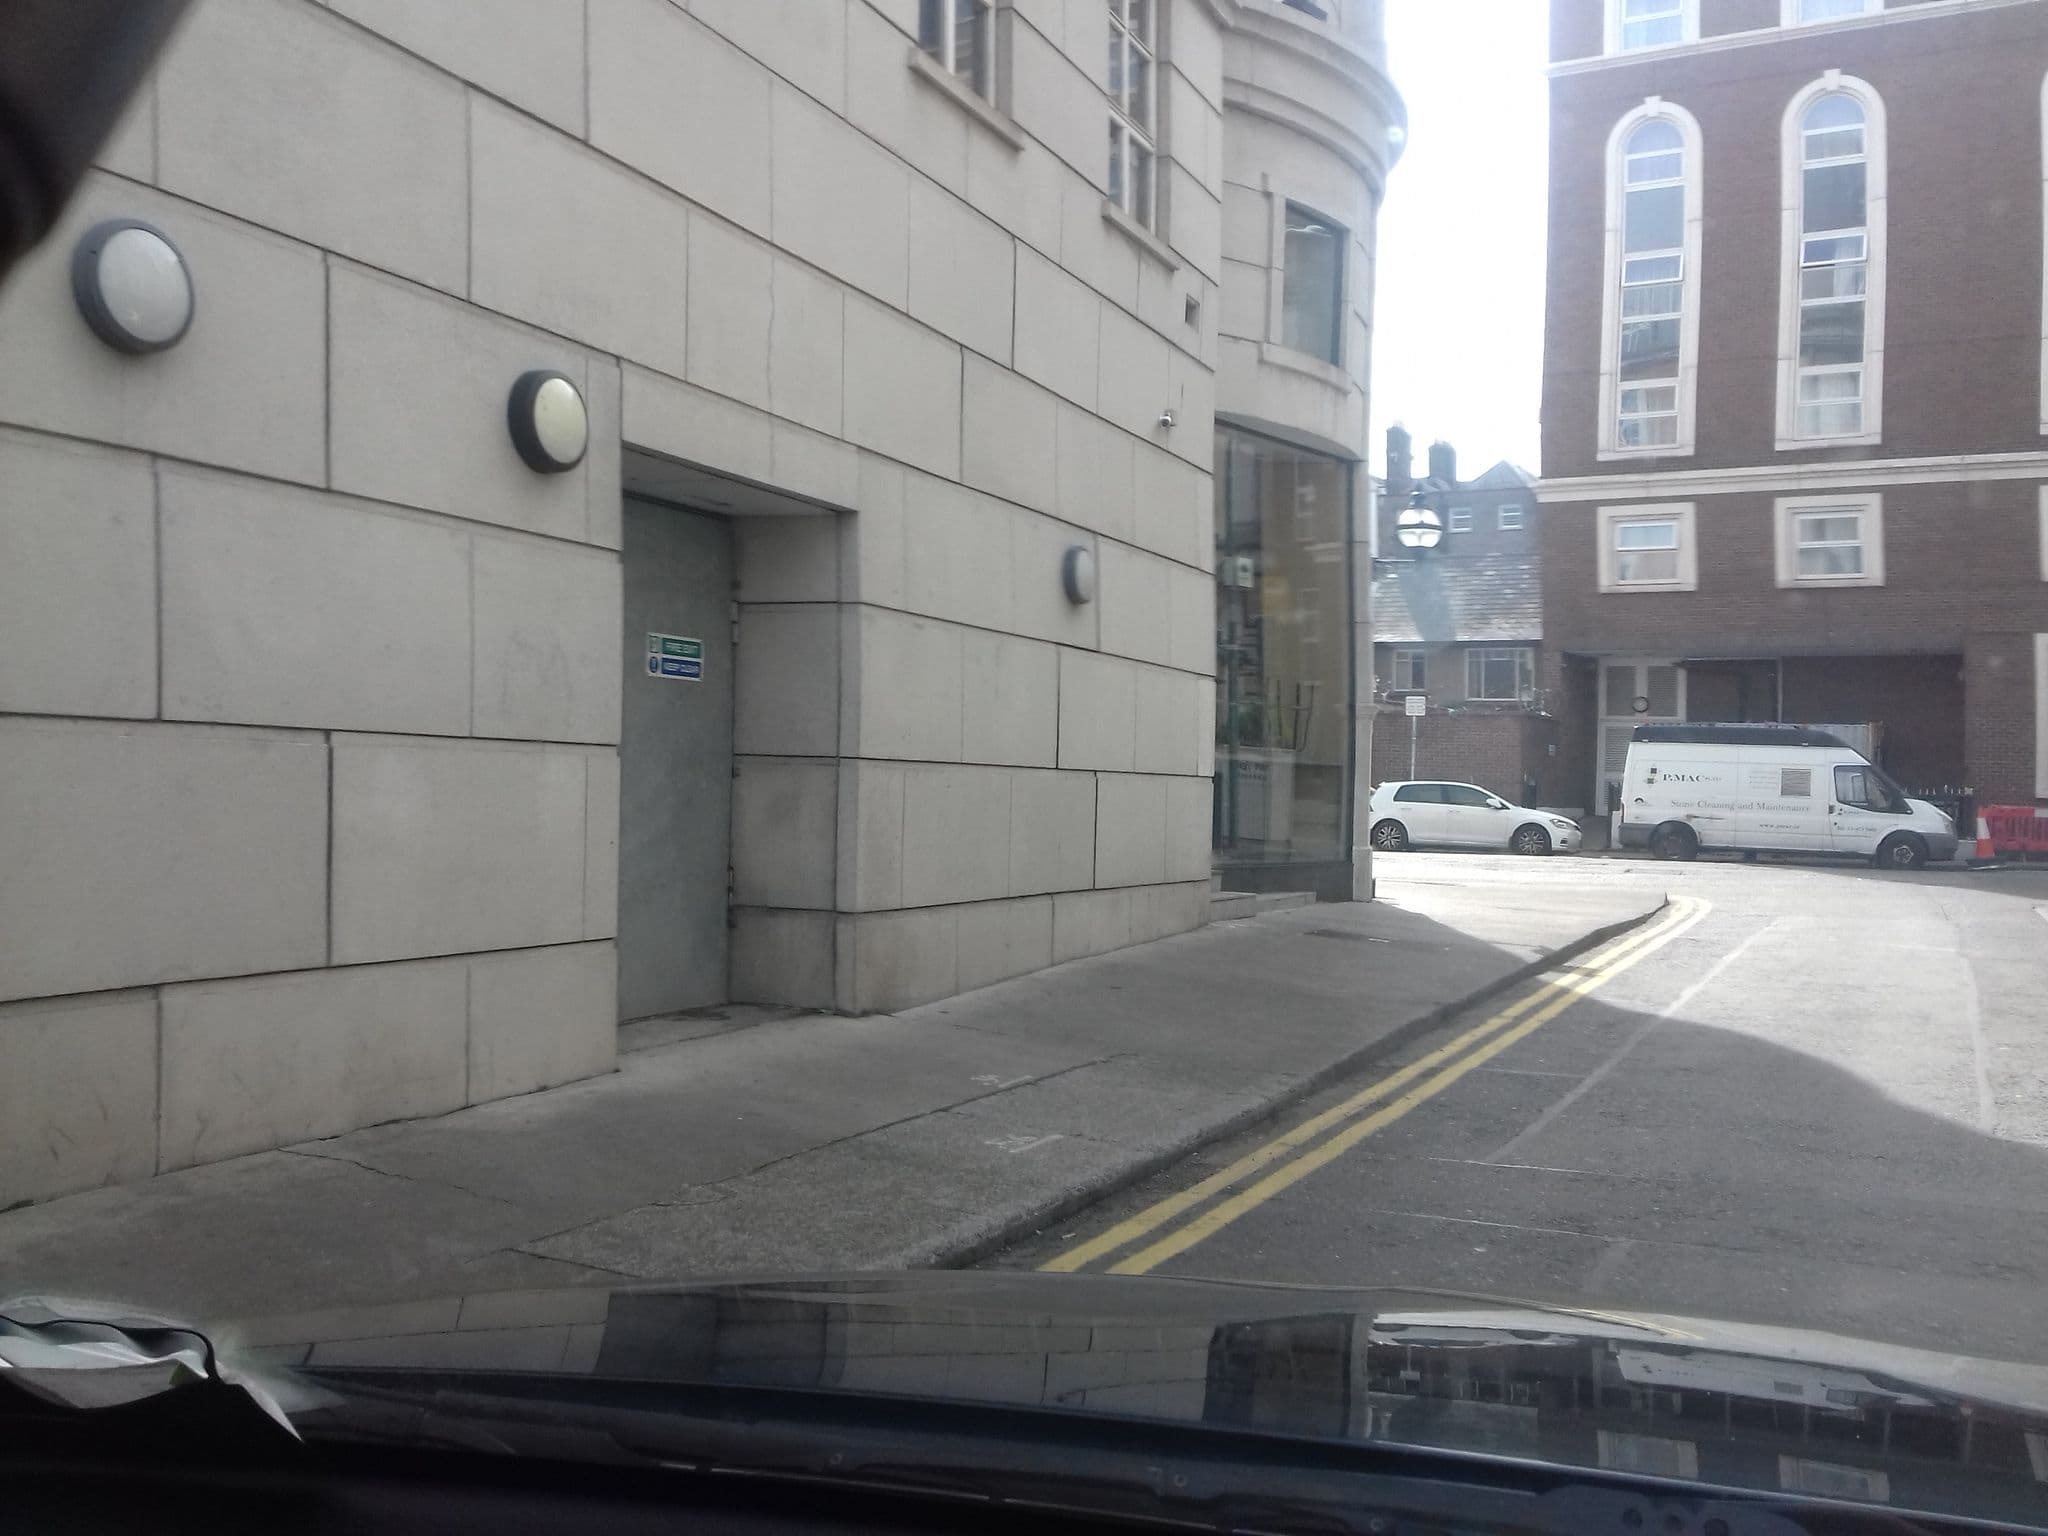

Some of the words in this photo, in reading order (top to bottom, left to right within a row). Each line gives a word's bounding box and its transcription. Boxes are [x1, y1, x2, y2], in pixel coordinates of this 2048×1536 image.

[1697, 800, 1735, 812] Cleaning
[1738, 801, 1753, 809] and
[1756, 802, 1809, 812] Maintenance
